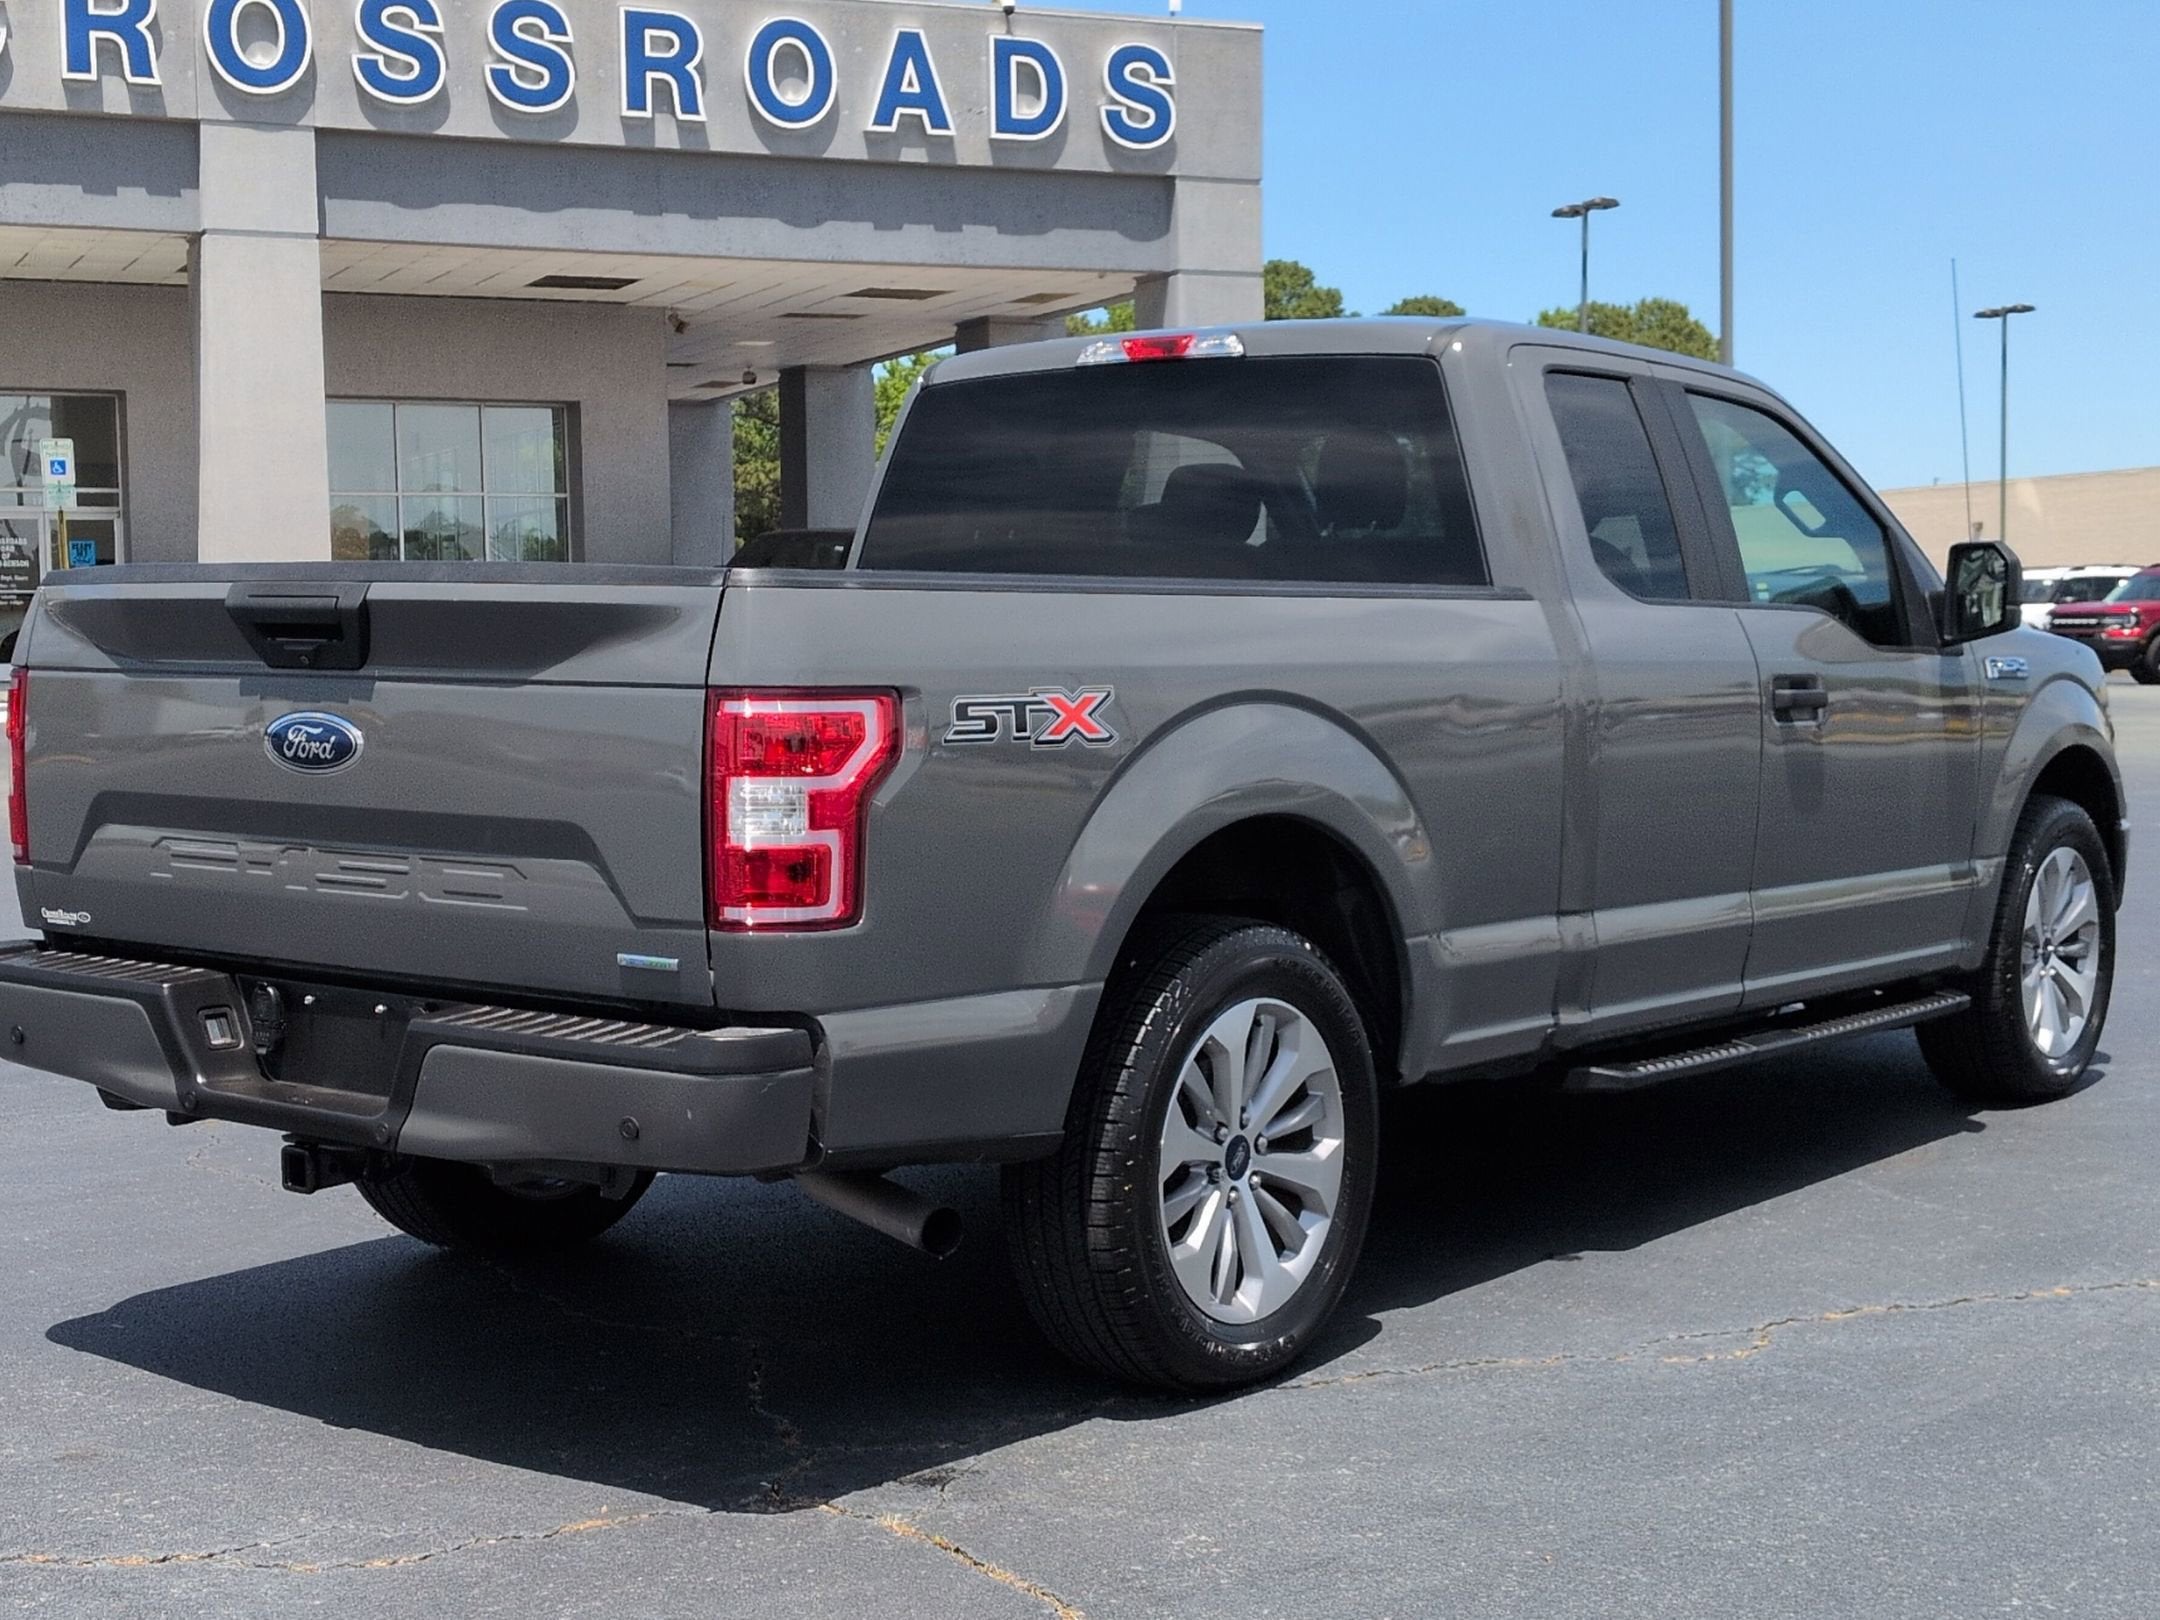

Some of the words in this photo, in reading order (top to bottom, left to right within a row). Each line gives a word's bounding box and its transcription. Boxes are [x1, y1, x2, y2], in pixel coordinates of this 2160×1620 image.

[0, 0, 1177, 150] ROSSROADS
[283, 724, 336, 759] Ford
[942, 684, 1119, 750] STX
